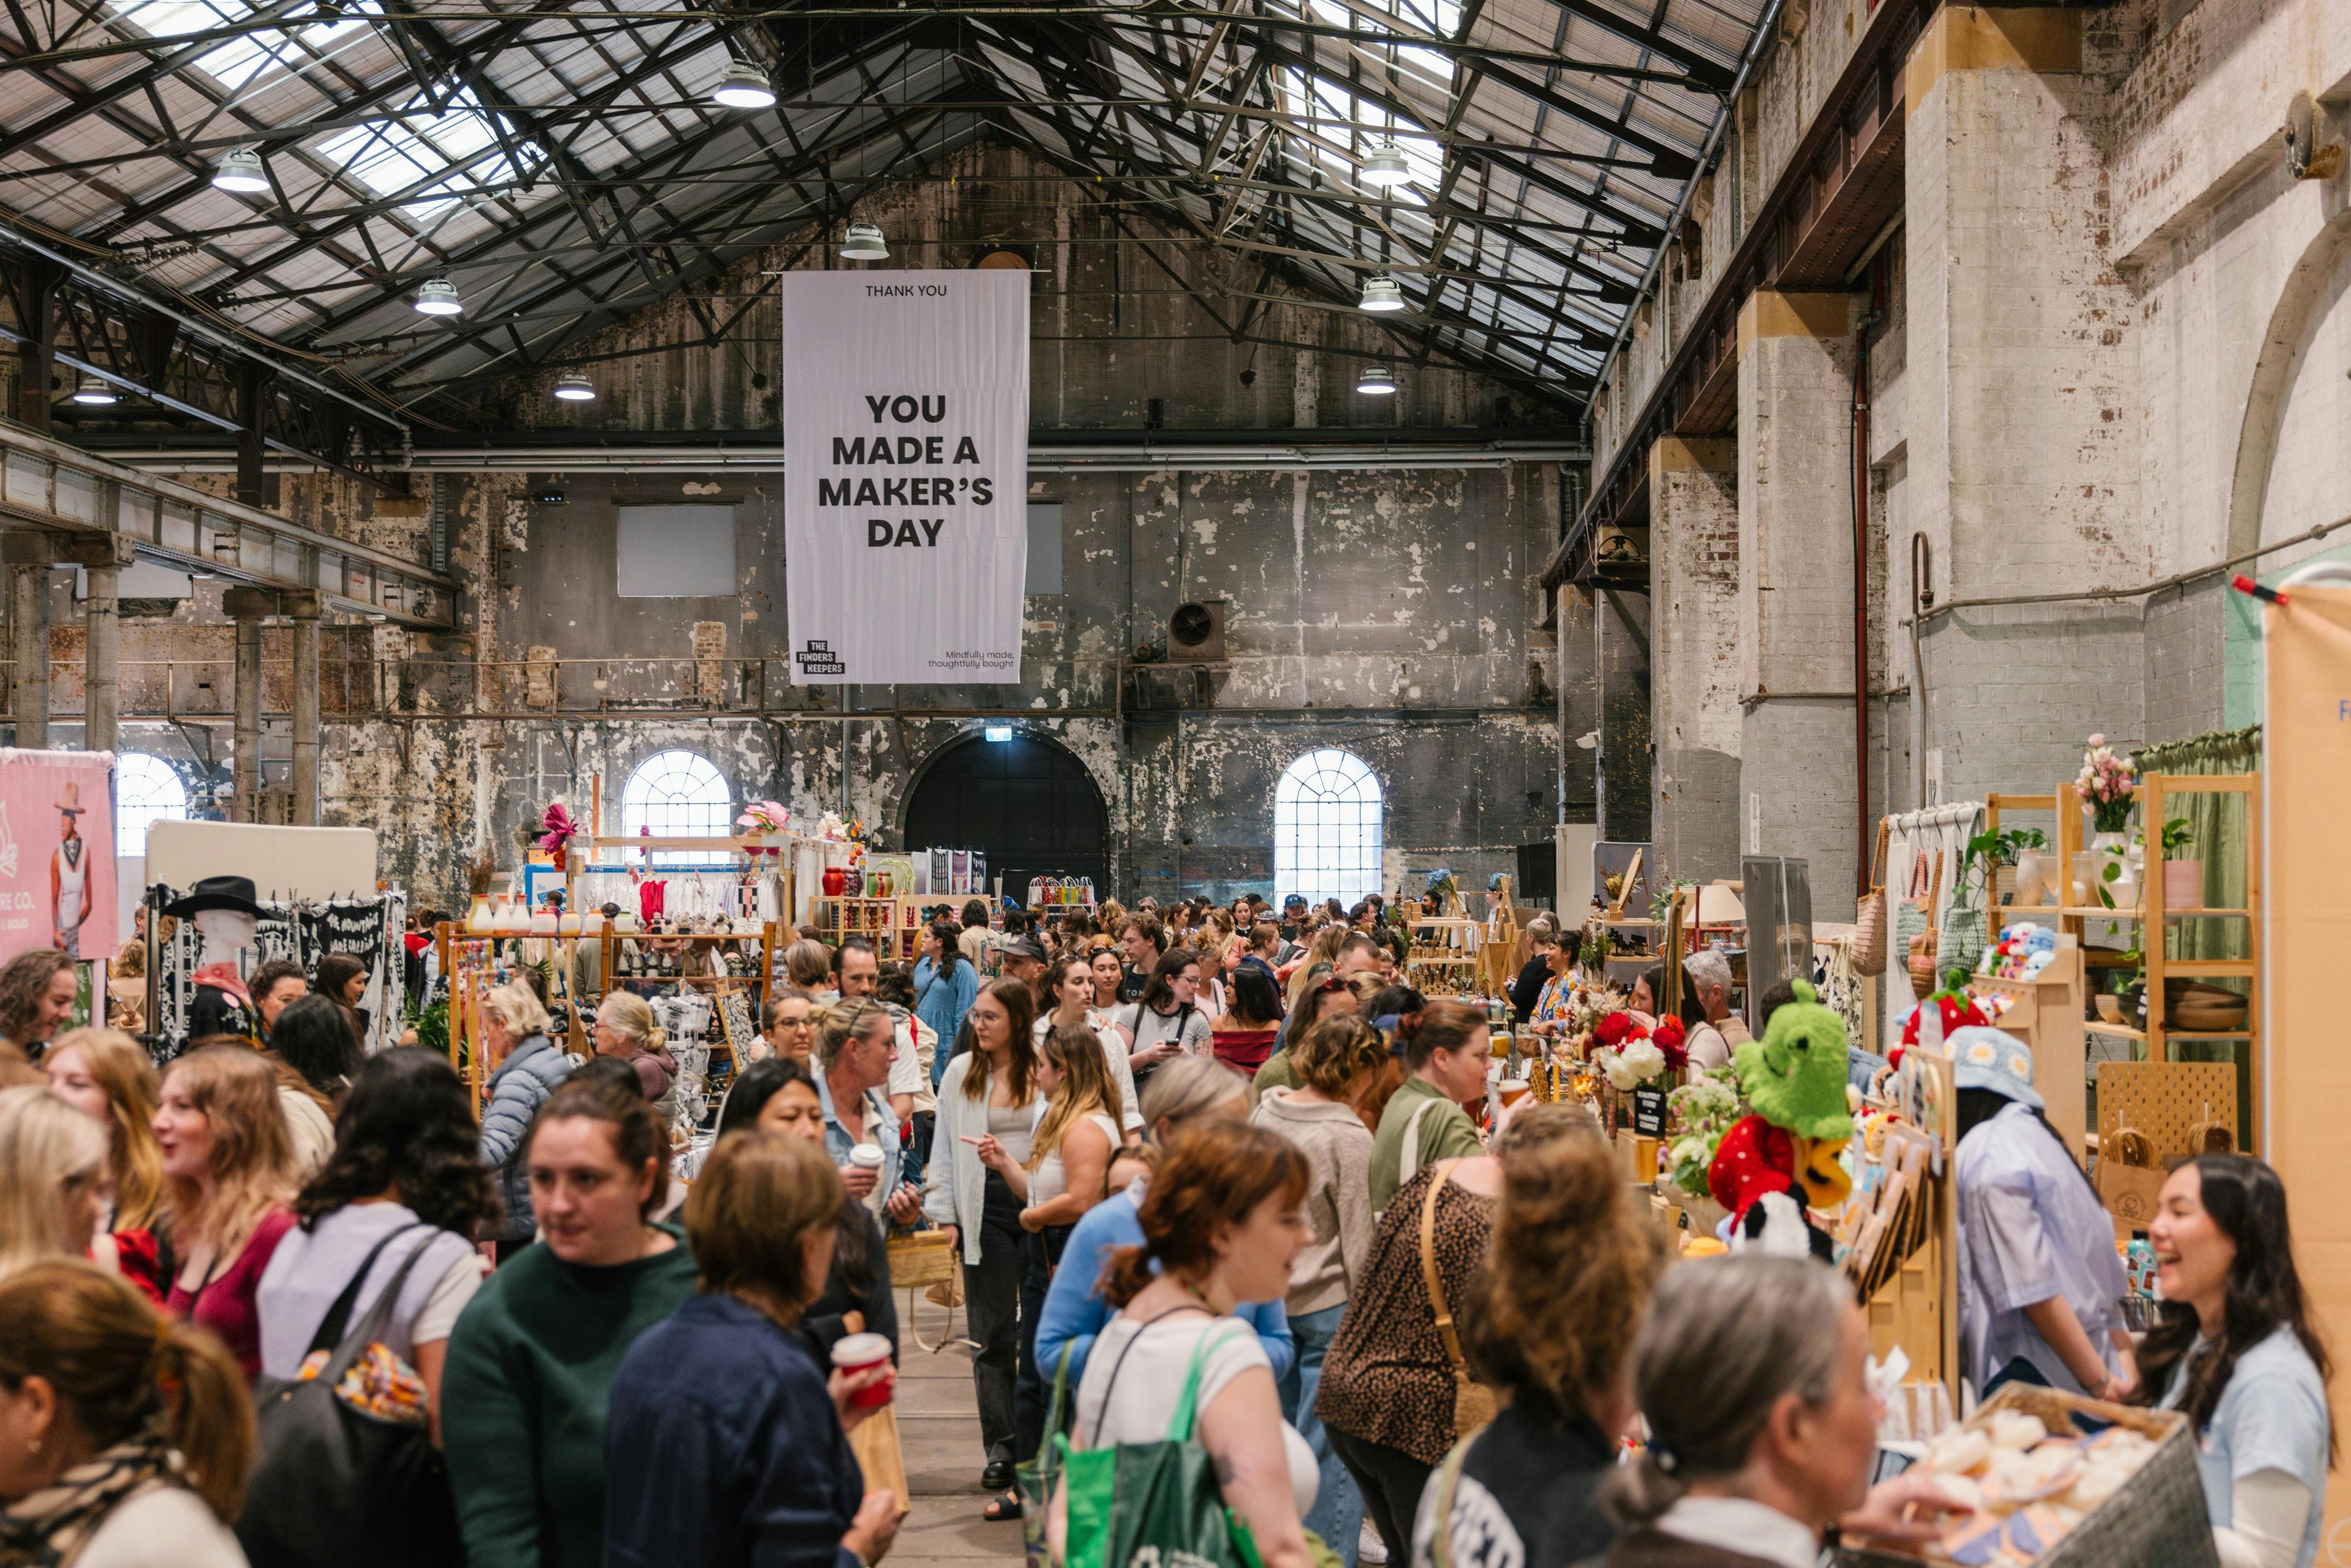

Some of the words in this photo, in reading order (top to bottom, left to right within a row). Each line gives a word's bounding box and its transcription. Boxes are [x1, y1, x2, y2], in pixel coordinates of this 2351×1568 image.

[865, 285, 913, 296] THANK
[917, 285, 947, 296] YOU
[865, 394, 946, 423] YOU
[832, 436, 943, 465] MADE
[952, 436, 980, 464] A
[819, 477, 993, 506] MAKER’S
[868, 519, 945, 547] DAY
[811, 641, 826, 651] THE
[799, 652, 833, 662] FINDERS
[946, 650, 984, 660] Mindfully
[807, 664, 843, 673] KEEPERS
[928, 659, 980, 669] thoughtfully
[982, 659, 1014, 669] bought
